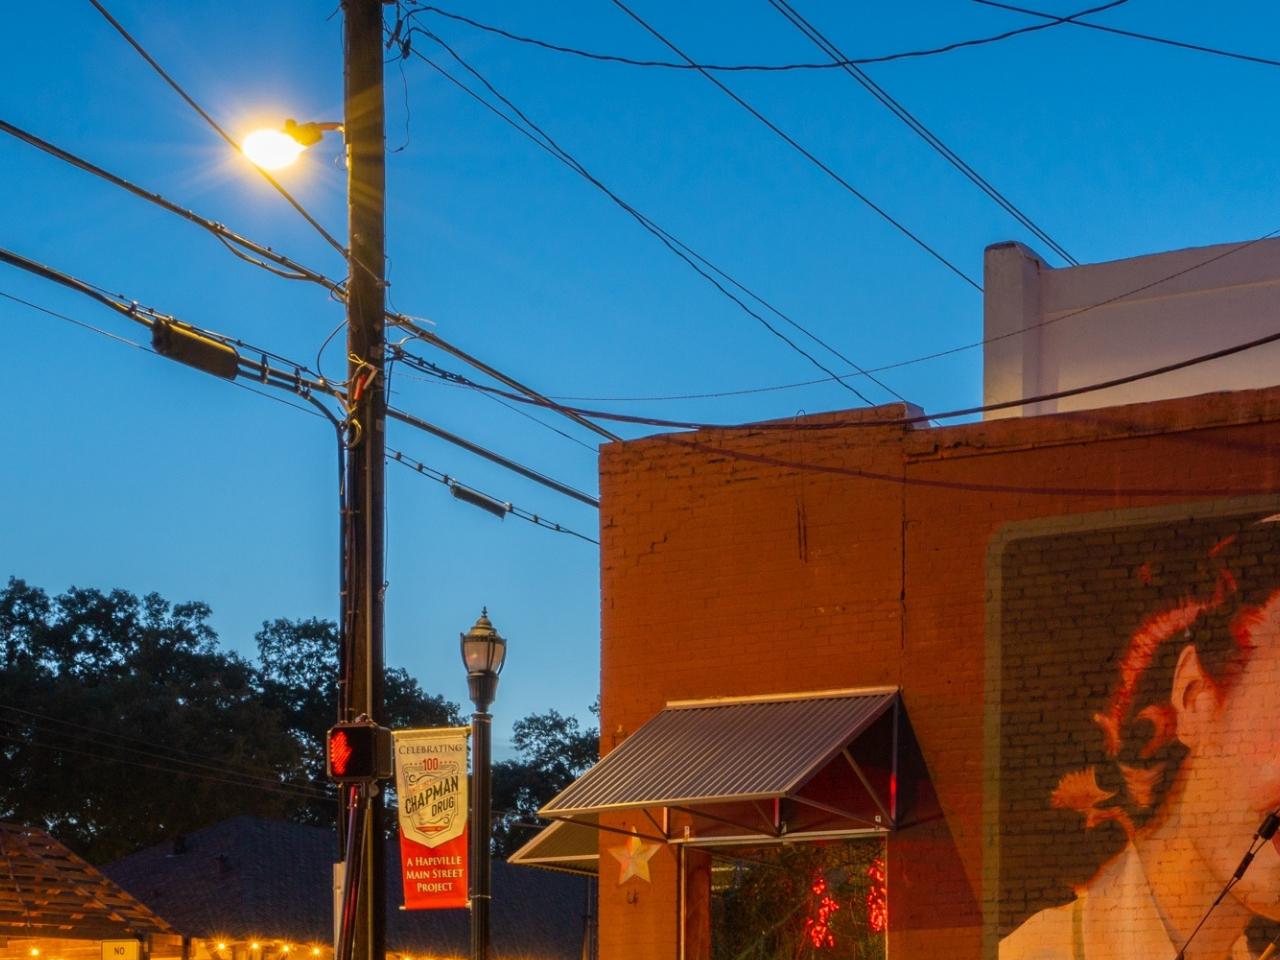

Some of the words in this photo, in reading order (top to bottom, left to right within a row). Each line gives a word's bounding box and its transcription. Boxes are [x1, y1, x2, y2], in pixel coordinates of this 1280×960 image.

[398, 743, 464, 756] CELEBRATING
[422, 758, 439, 772] 100
[405, 775, 459, 815] CHAPMAN
[431, 796, 455, 817] DRUG
[407, 857, 414, 867] A
[416, 855, 463, 867] HAPEVILLE
[406, 868, 431, 880] MAIN
[432, 867, 465, 879] STREET
[417, 881, 454, 893] PROJECT
[114, 947, 125, 955] NO
